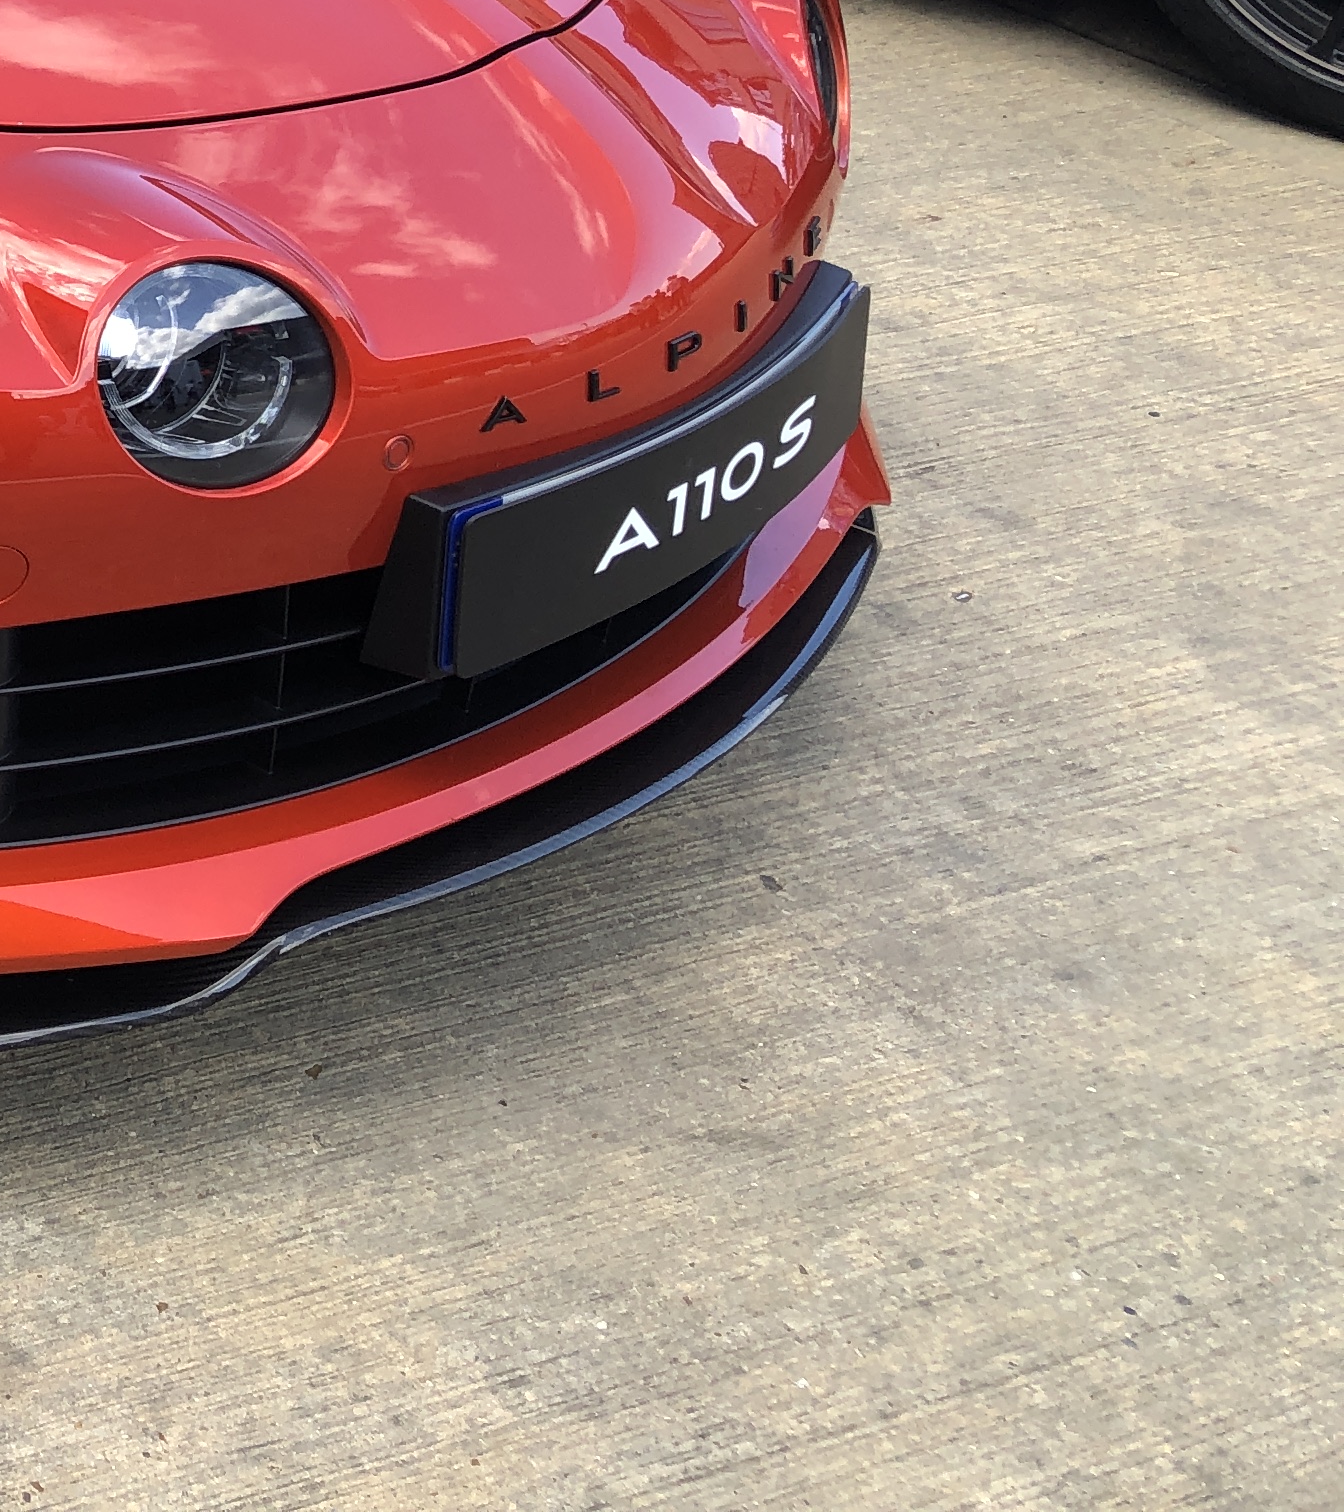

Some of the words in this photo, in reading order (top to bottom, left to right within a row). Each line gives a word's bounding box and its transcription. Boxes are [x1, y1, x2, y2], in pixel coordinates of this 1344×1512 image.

[479, 215, 823, 433] ALPINE
[594, 441, 764, 575] A110
[772, 394, 817, 470] S
